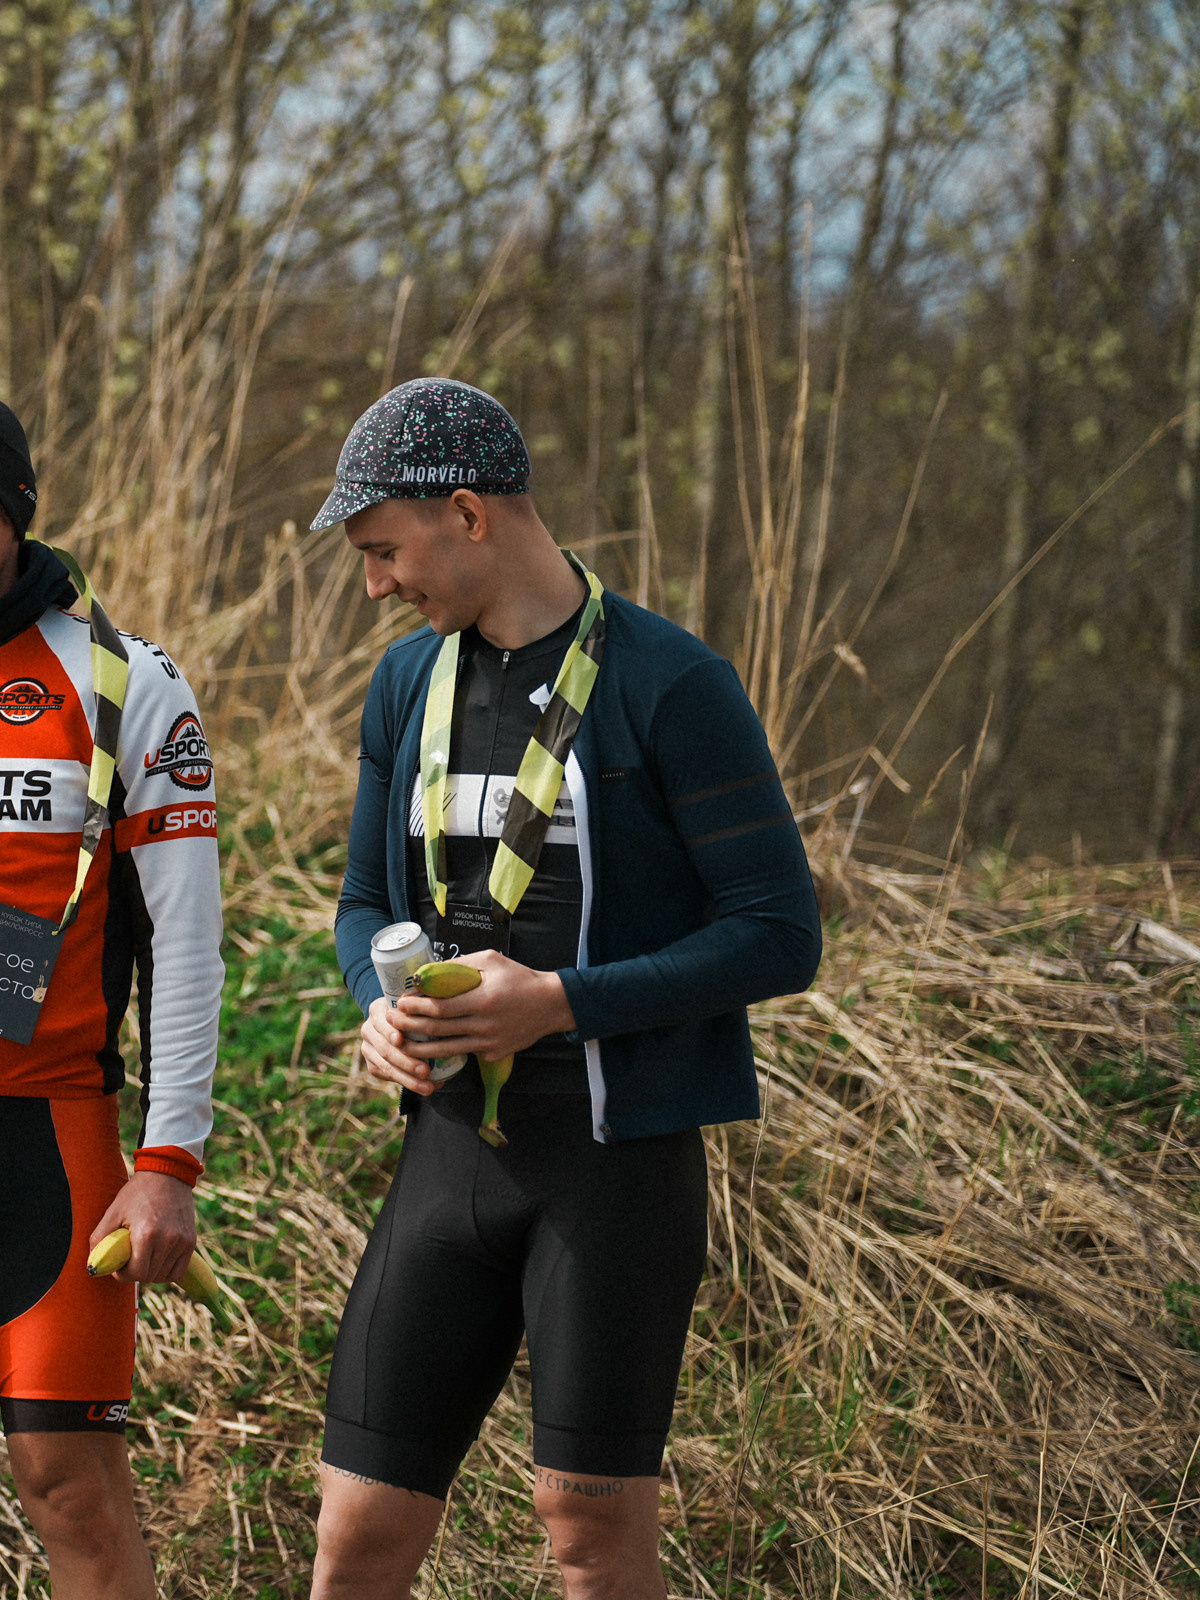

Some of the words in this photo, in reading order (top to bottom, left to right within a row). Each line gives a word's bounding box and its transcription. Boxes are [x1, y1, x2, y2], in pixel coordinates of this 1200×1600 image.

[402, 464, 477, 484] MORVÉLO
[1, 911, 24, 924] КУБОК
[454, 911, 474, 921] КУБОК
[475, 913, 491, 922] ТИПА
[452, 919, 494, 931] ЦИКЛОКРОСС
[546, 1474, 624, 1497] СТРАШНО
